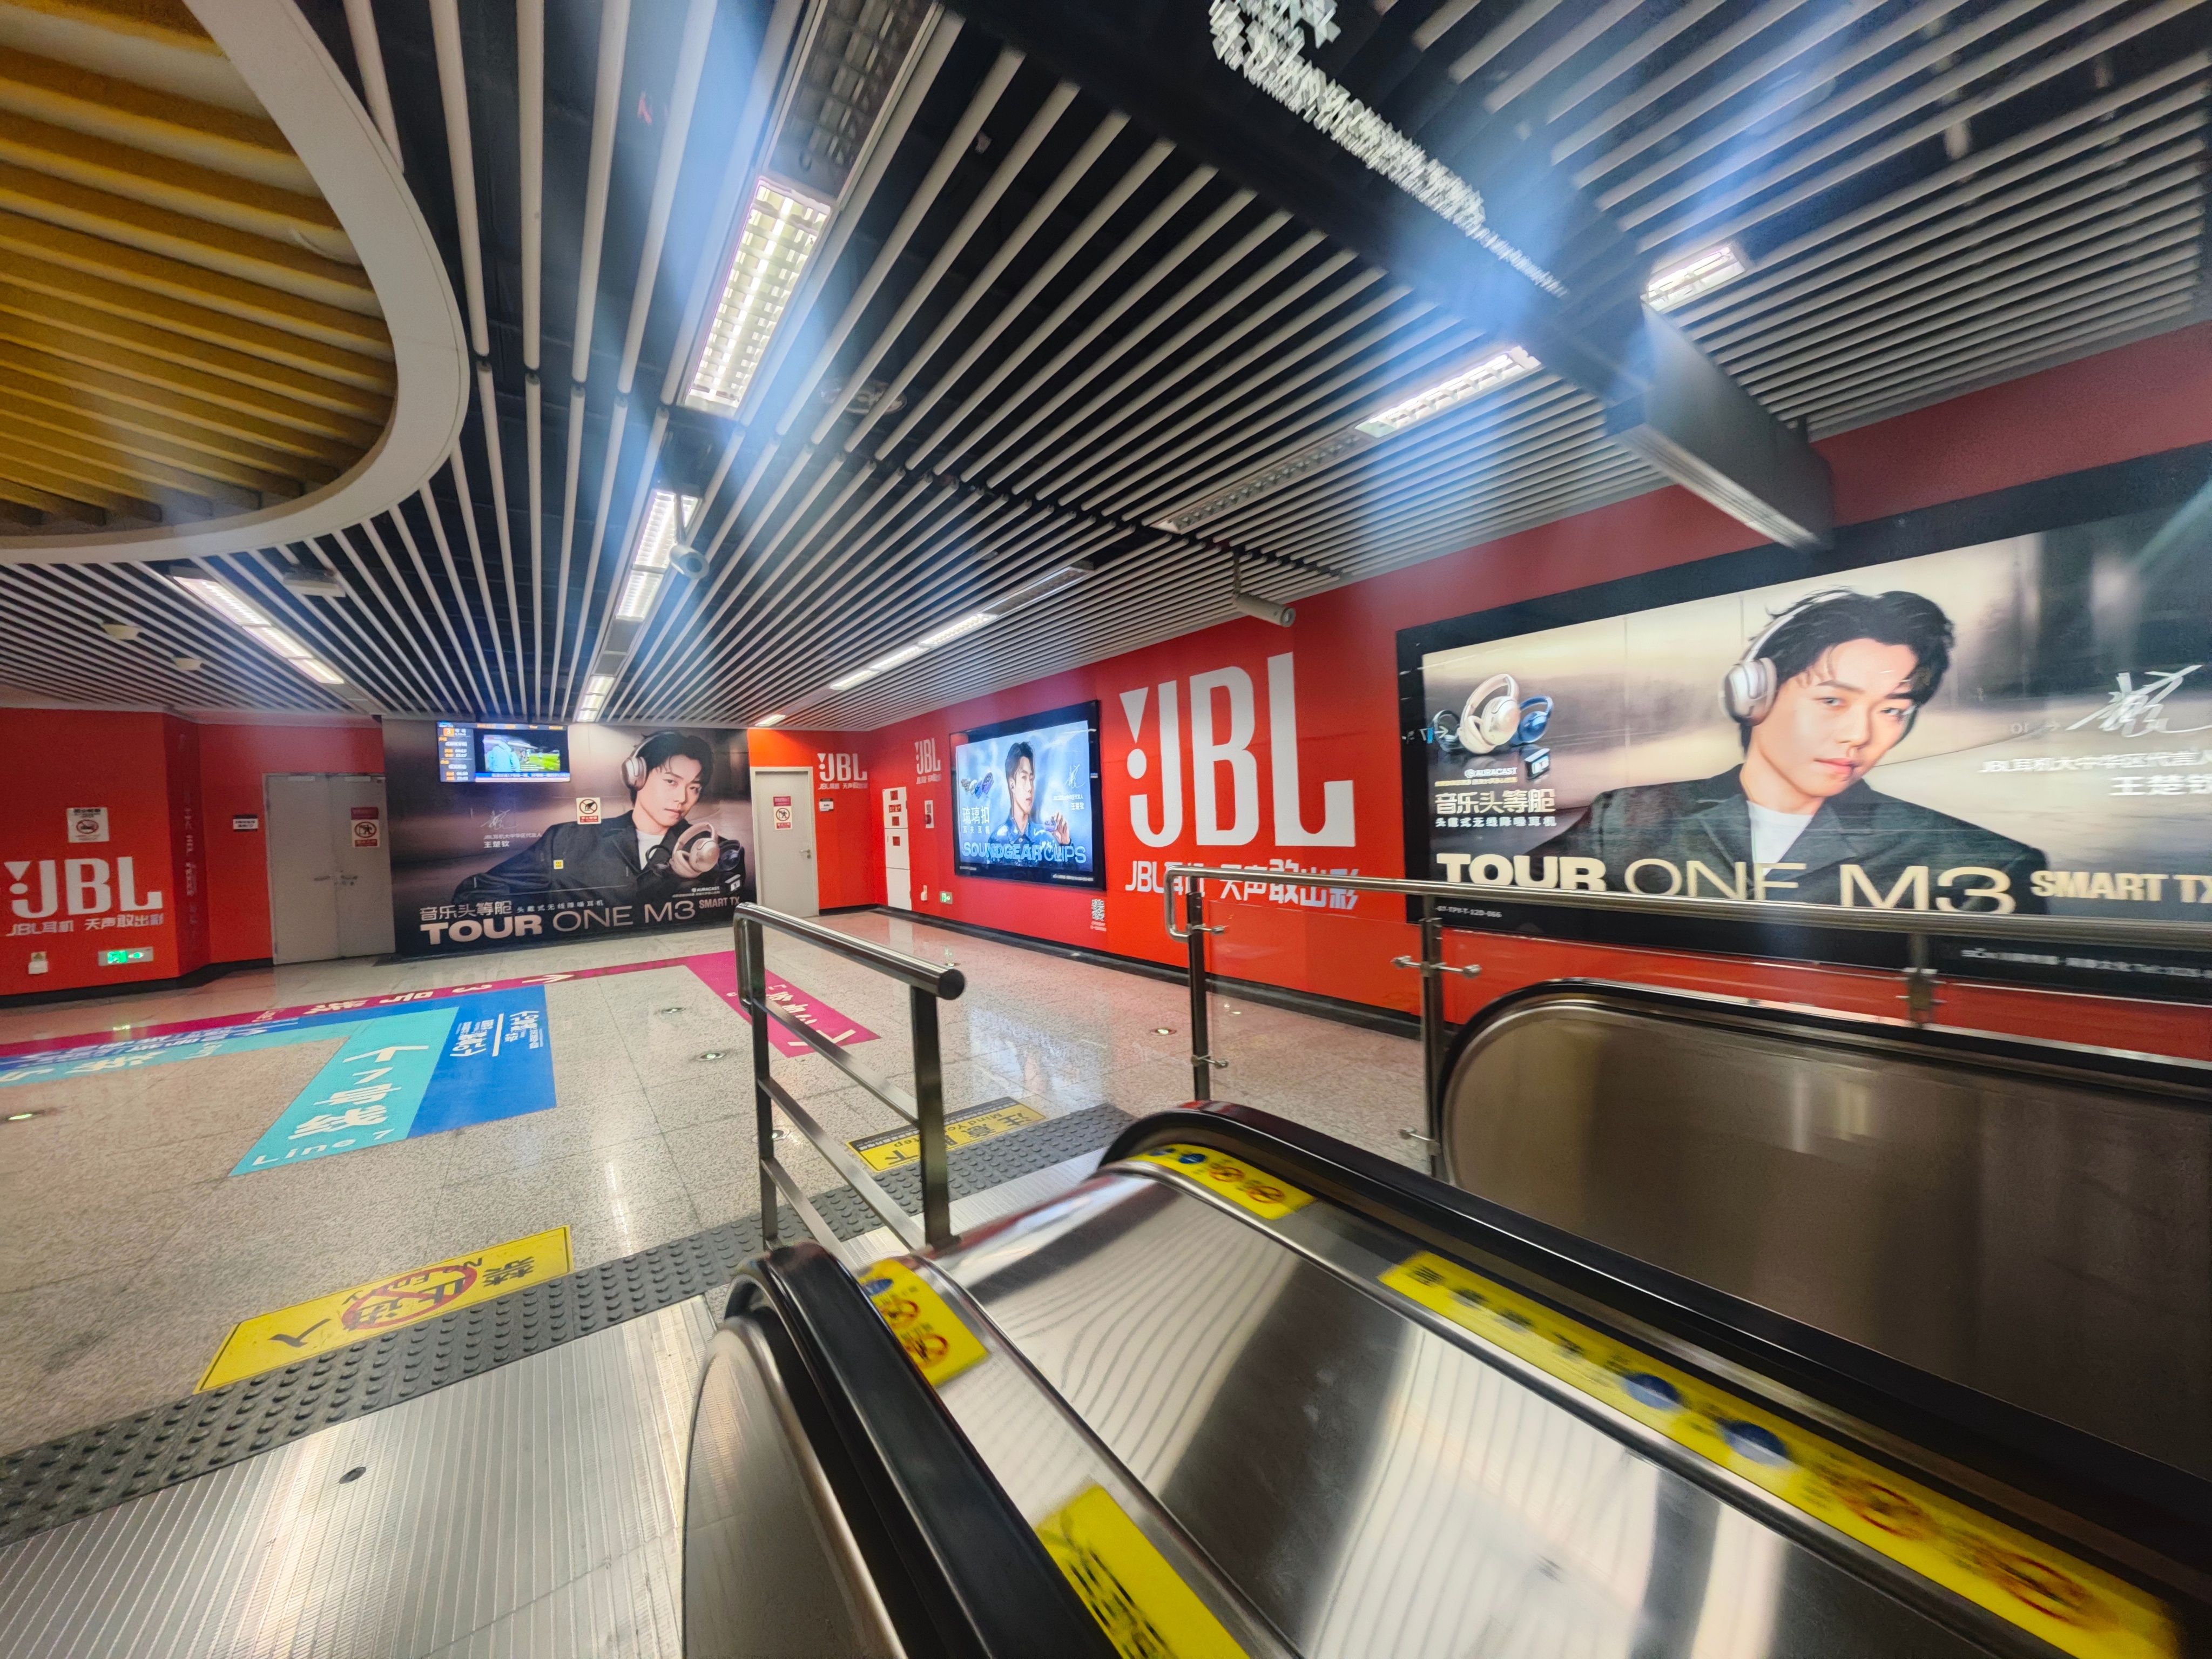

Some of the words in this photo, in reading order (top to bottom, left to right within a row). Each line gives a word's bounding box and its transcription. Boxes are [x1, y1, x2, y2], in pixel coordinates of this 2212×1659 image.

[914, 737, 941, 774] JBL
[1120, 651, 1355, 847] JBL
[817, 753, 868, 781] JBL
[962, 806, 990, 824] 琉璃扣
[1435, 788, 1556, 814] 音乐头等舱
[962, 841, 1042, 861] SOUNDGEAR
[1044, 844, 1087, 864] CLIPS
[4, 856, 163, 919] JBL
[1437, 853, 1607, 892] TOUR
[1840, 864, 2017, 915] M3
[2030, 869, 2168, 901] SMART
[420, 900, 512, 921] 音乐头等舱
[699, 897, 728, 909] SMART
[420, 914, 543, 945] TOUR
[552, 905, 633, 932] ONE
[644, 900, 696, 924] M3
